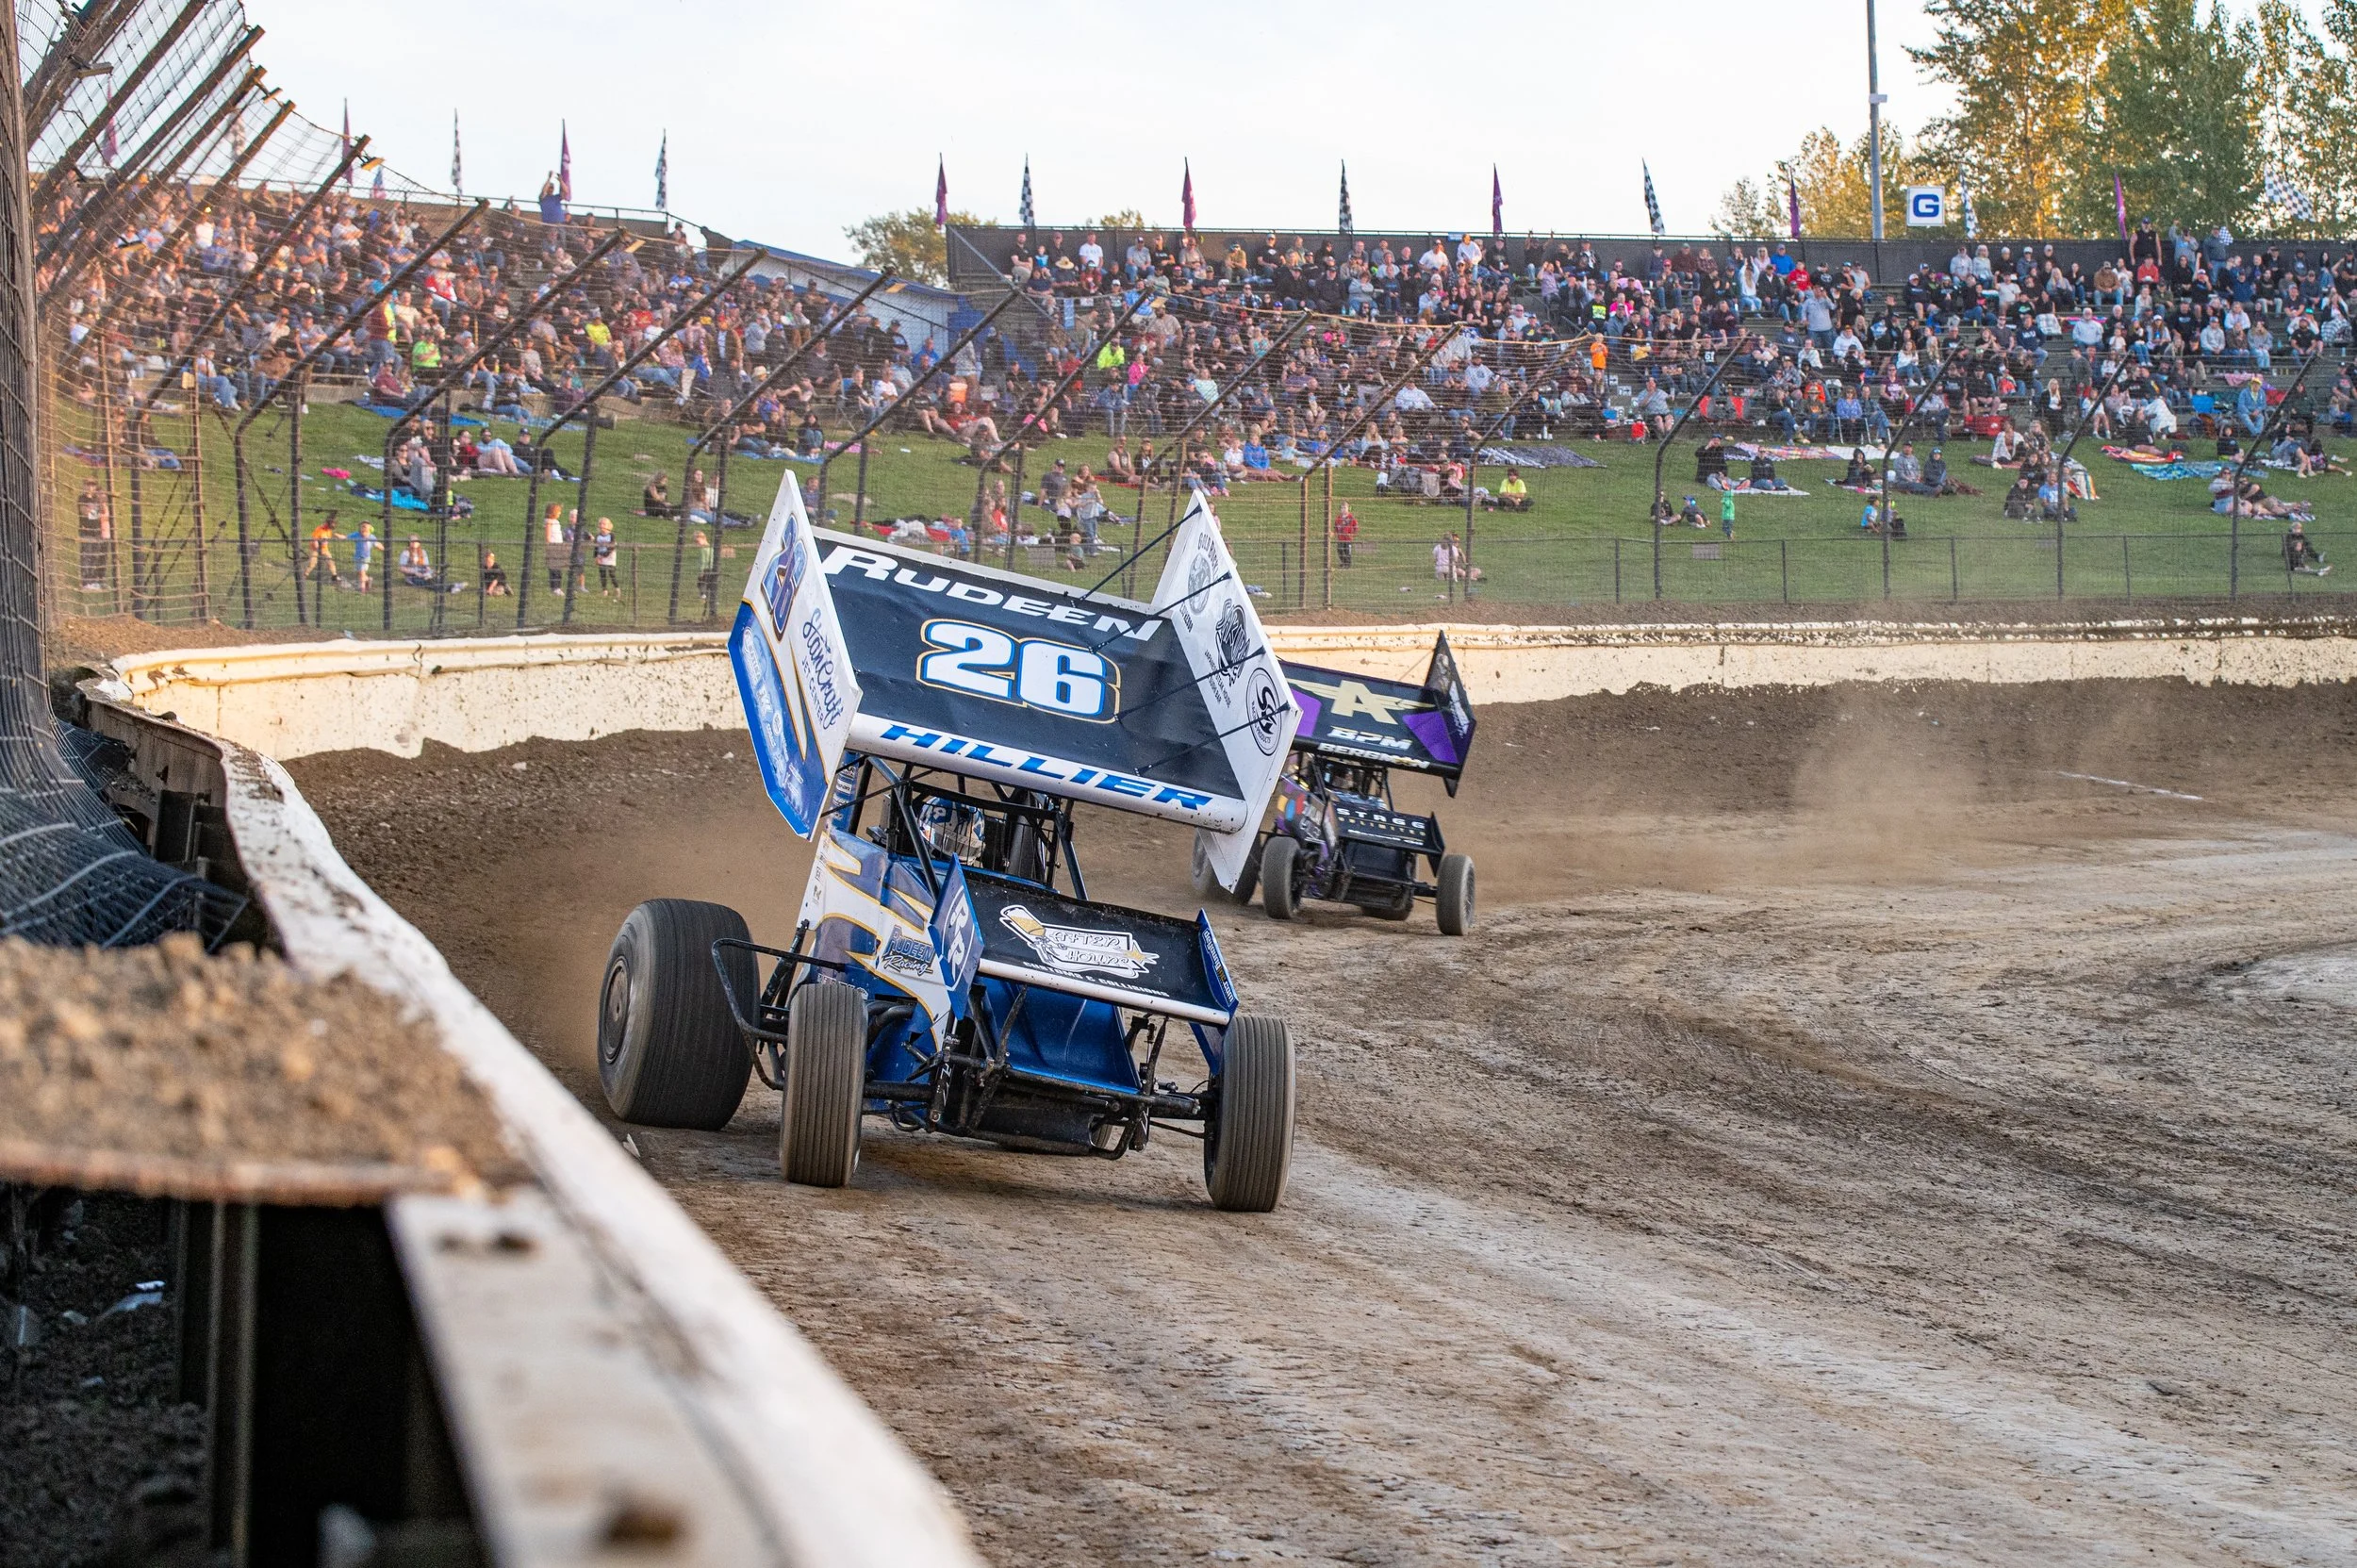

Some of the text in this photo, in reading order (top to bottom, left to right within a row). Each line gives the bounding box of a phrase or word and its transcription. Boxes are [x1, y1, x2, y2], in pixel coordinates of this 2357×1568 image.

[1912, 193, 1940, 218] G
[761, 512, 808, 641] 26
[821, 545, 1163, 642] RUDEEN
[801, 655, 825, 725] JET CENTER
[916, 619, 1122, 724] 26
[880, 723, 1213, 812] HILLIER
[882, 924, 936, 963] RUDEEN
[882, 954, 934, 977] Racing
[1023, 961, 1084, 980] CUSTOMS
[1098, 978, 1171, 999] COLLISIONS
